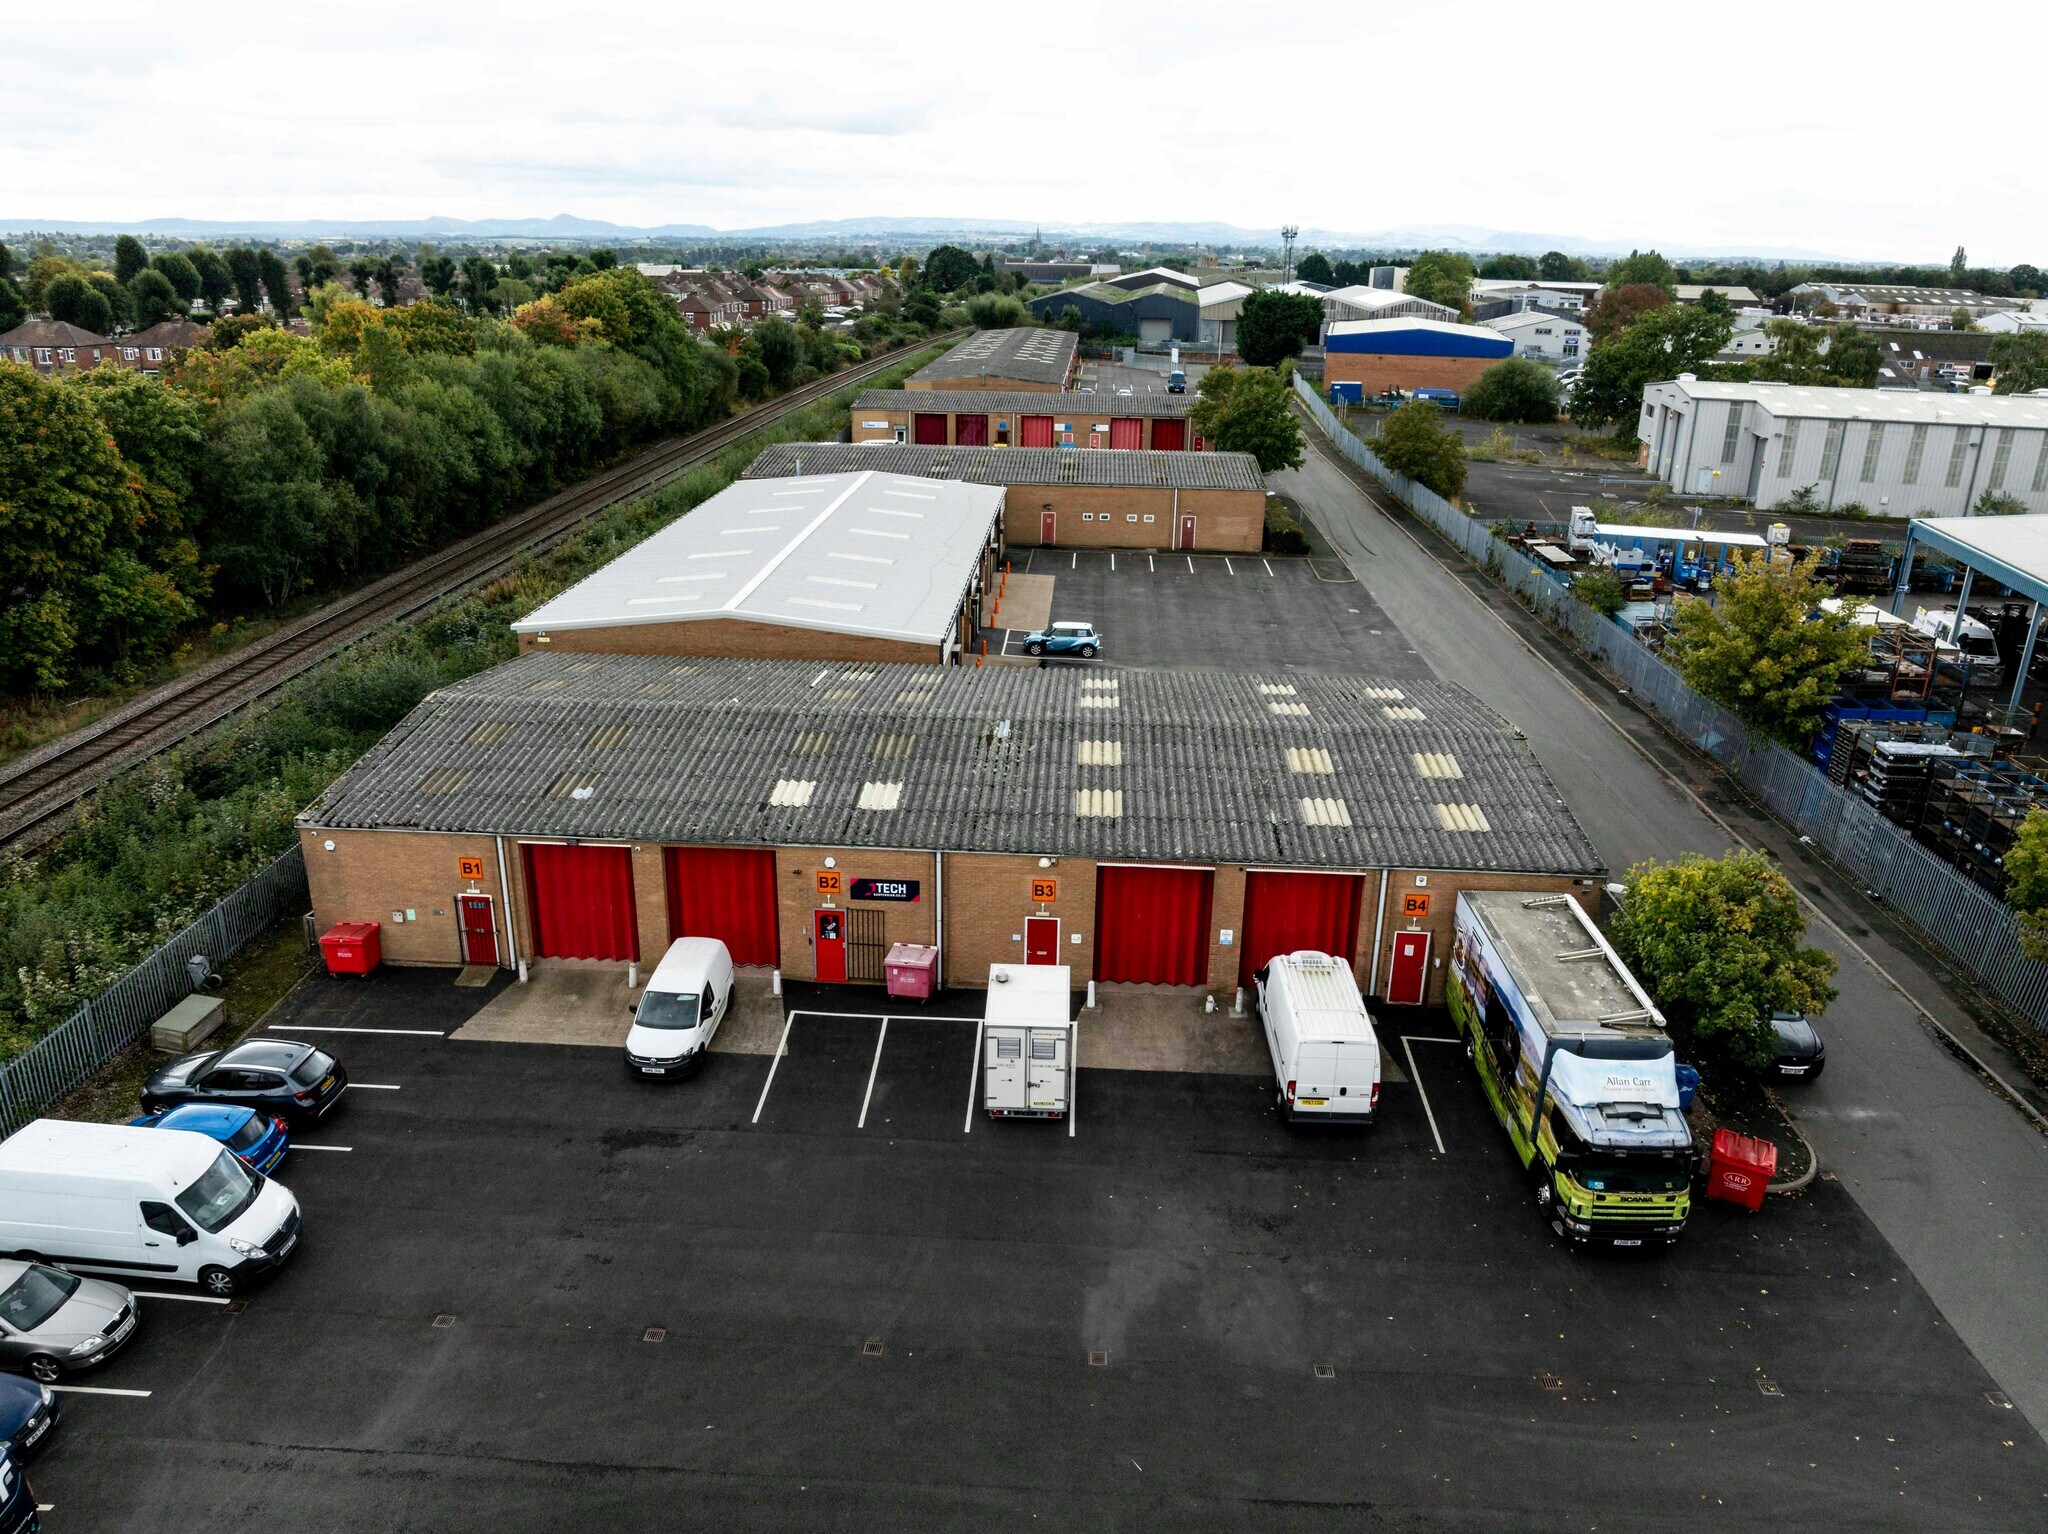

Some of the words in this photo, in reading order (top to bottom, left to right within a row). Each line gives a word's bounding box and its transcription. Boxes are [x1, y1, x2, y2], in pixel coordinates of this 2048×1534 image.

[462, 862, 480, 874] B1
[819, 876, 838, 889] B2
[1034, 885, 1053, 897] B3
[1406, 899, 1426, 911] B4
[1607, 1077, 1630, 1086] Allan
[1632, 1077, 1651, 1086] Carr
[1728, 1175, 1747, 1184] ARR
